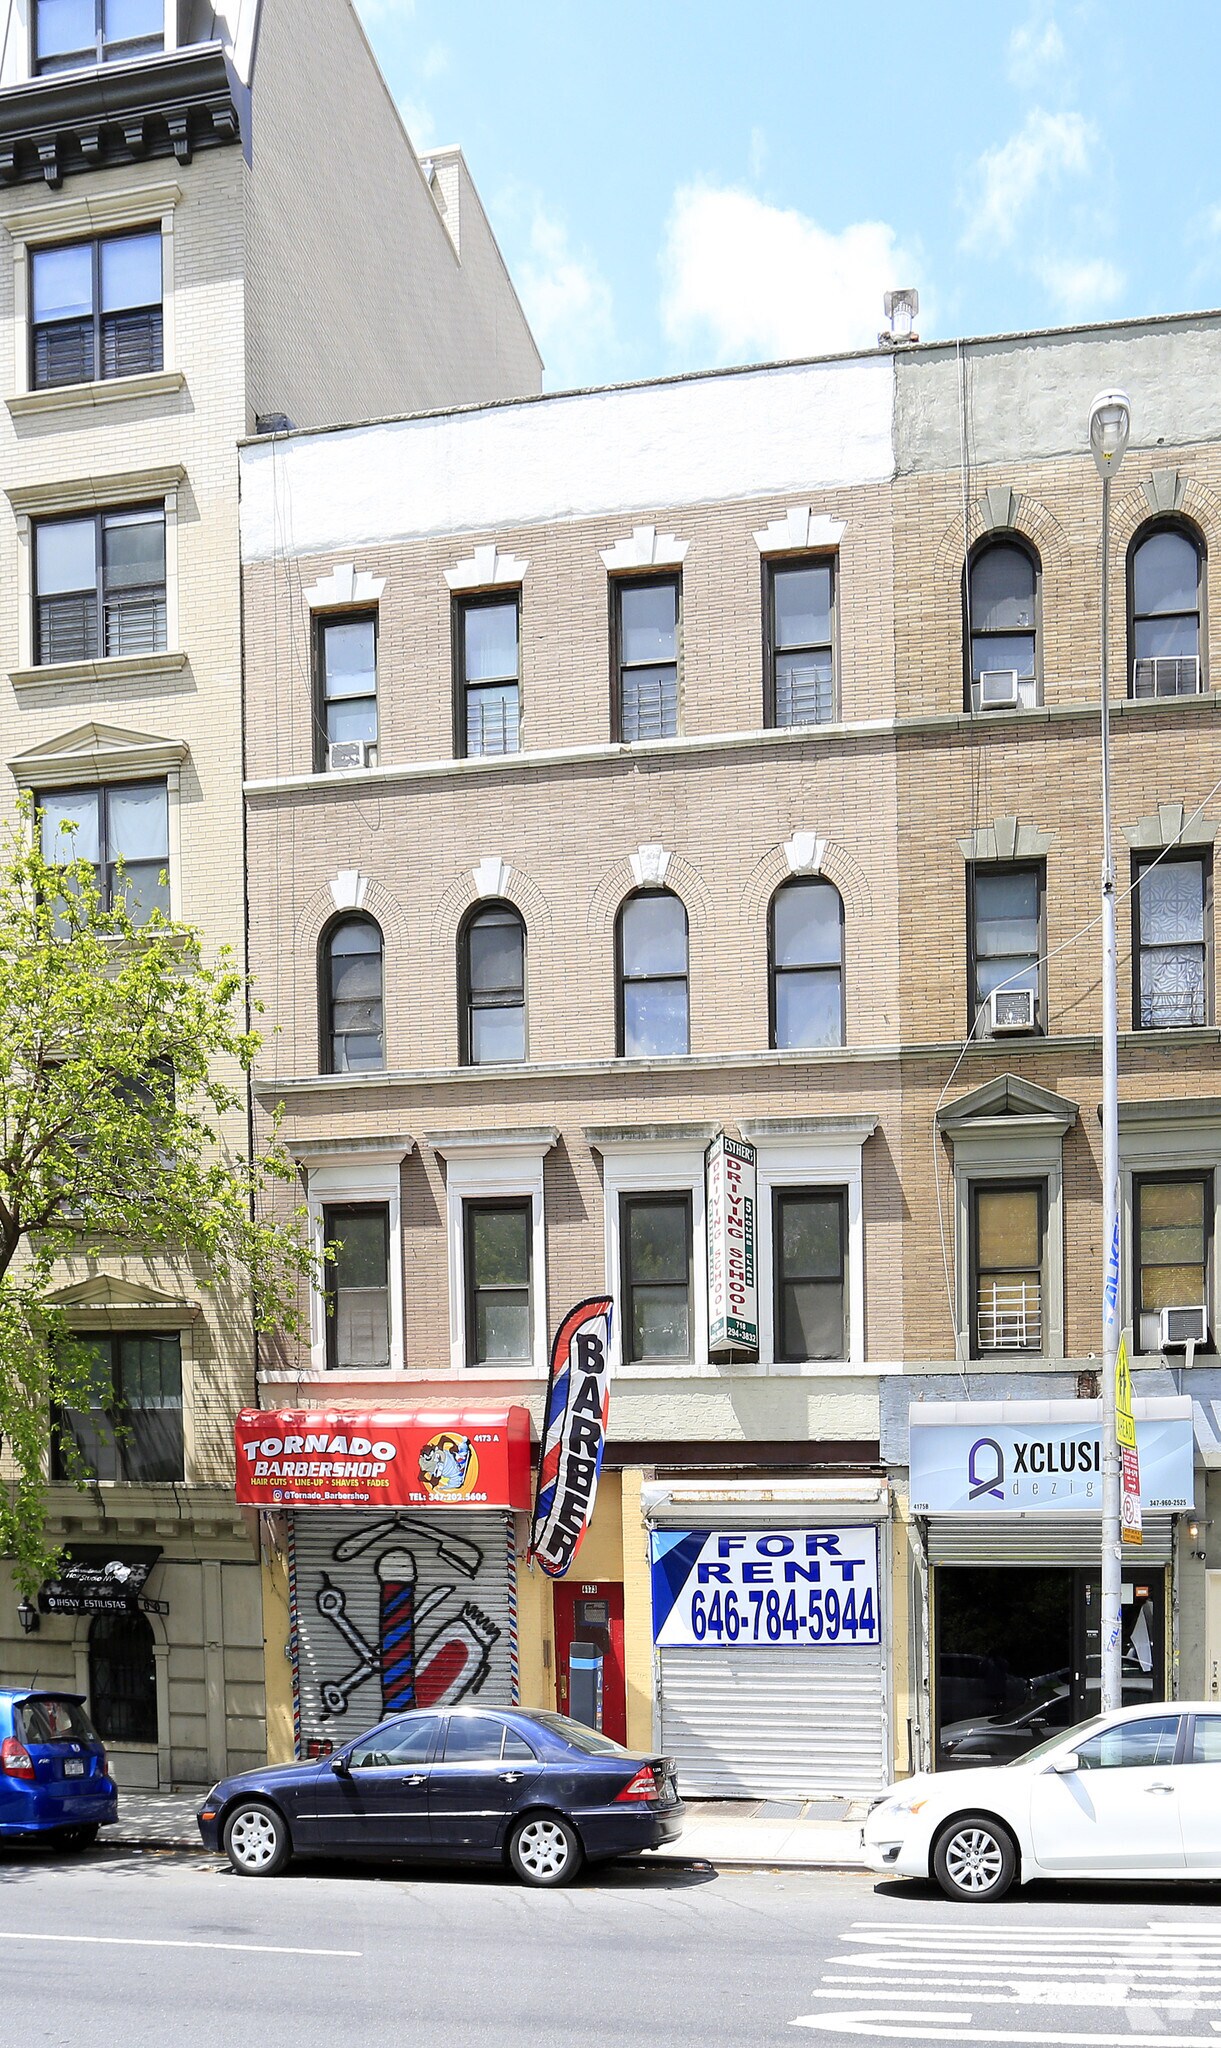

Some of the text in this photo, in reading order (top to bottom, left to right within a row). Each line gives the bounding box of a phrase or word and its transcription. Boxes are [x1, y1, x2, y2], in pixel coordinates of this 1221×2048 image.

[726, 1158, 746, 1317] DRIVING SCHOOL
[735, 1321, 746, 1330] 718
[243, 1434, 397, 1461] TORNADO
[545, 1333, 605, 1568] BARBER
[1013, 1441, 1101, 1473] XCLUSI
[253, 1461, 387, 1478] BARBERSHOP
[251, 1478, 390, 1487] HAIR CUTS LINE-UP SHAVES FADES
[1012, 1480, 1095, 1498] dezig
[284, 1491, 370, 1501] @Tornado_Barbershop
[409, 1493, 426, 1501] TEL:
[718, 1533, 842, 1558] FOR
[697, 1560, 866, 1584] RENT
[691, 1587, 876, 1641] 646-784-5944
